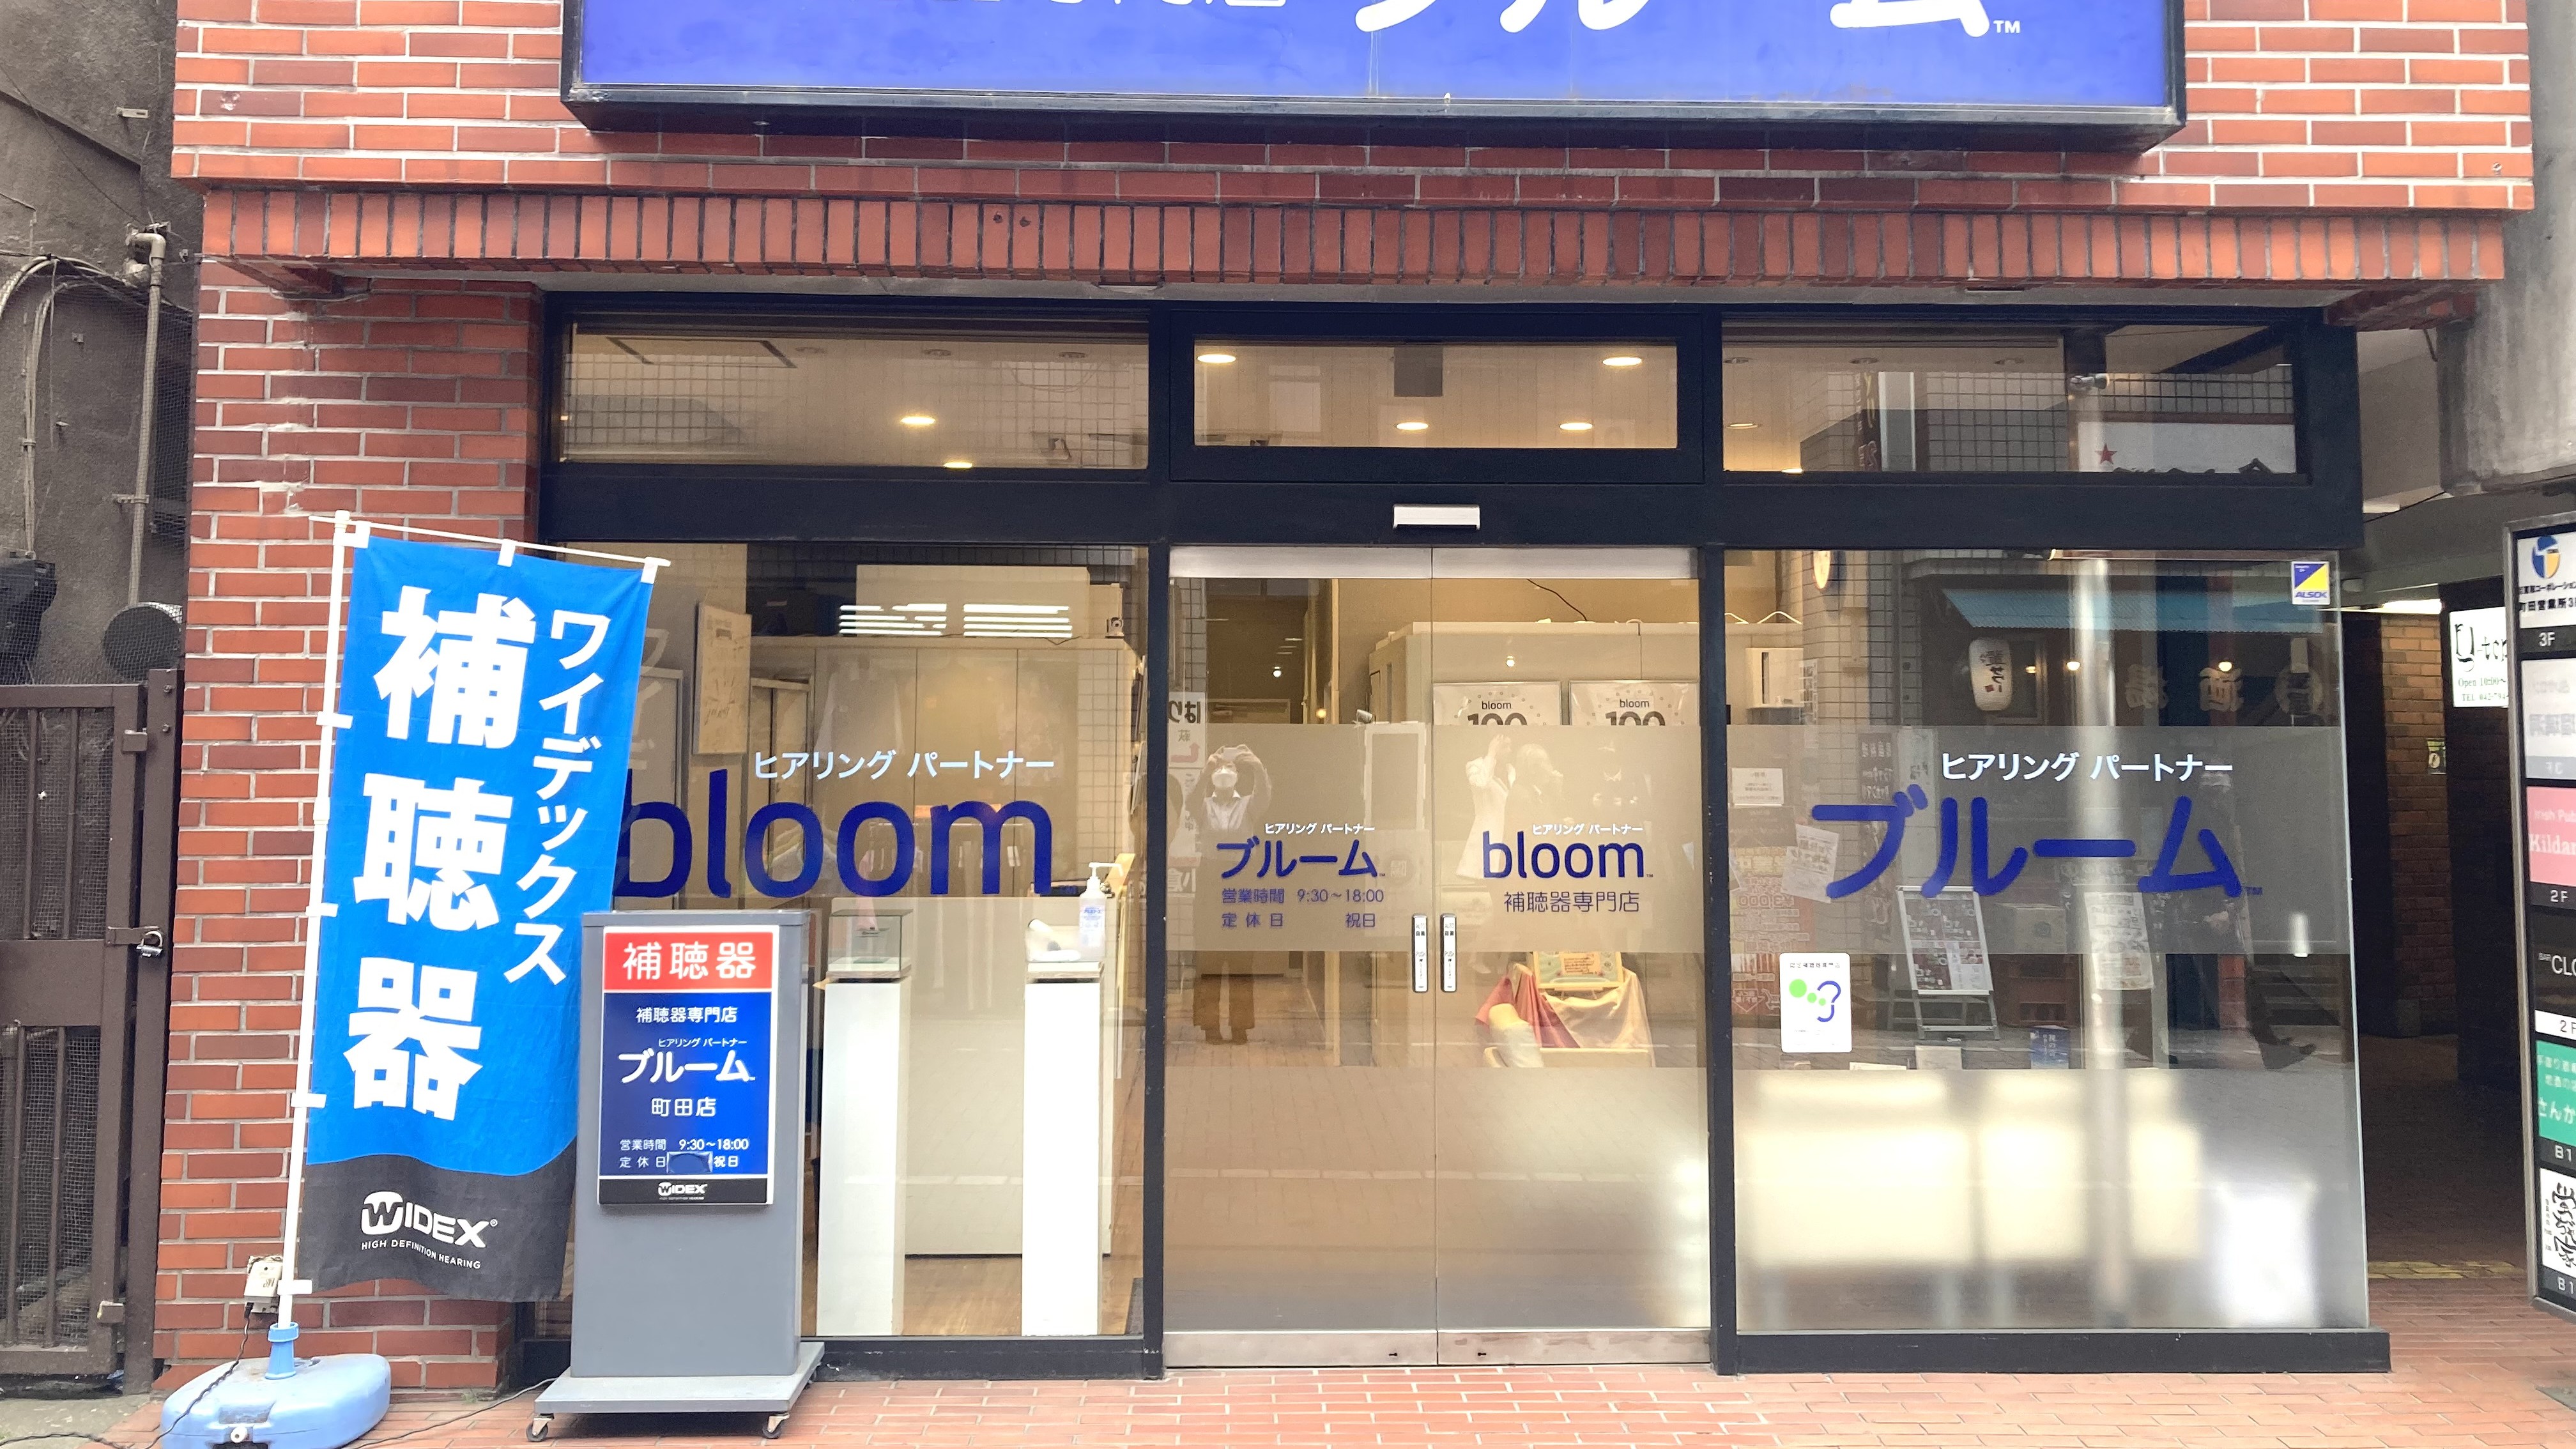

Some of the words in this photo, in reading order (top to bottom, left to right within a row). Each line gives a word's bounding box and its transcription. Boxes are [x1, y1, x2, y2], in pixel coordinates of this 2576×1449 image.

[2538, 631, 2556, 647] 3F
[2458, 678, 2477, 688] Open
[1481, 700, 1512, 710] bloom
[1619, 698, 1650, 709] bloom
[754, 749, 896, 780] ヒアリング
[907, 749, 1055, 780] パートナー
[1942, 751, 2080, 781] ヒアリング
[2090, 753, 2233, 781] パートナー
[503, 609, 611, 986] ワイデックス
[613, 769, 1053, 899] bloom
[1265, 822, 1317, 834] ヒアリング
[1321, 823, 1375, 834] パートナー
[1533, 823, 1585, 836] ヒアリング
[1589, 824, 1643, 835] パートナー
[1811, 784, 2242, 900] ブルーム
[343, 585, 537, 1121] 補聴器
[1216, 835, 1378, 878] ブルーム
[1482, 831, 1644, 879] bloom
[1222, 887, 1285, 904] 営業時間
[1504, 891, 1640, 912] 補聴器専門店
[2550, 889, 2569, 903] 2F
[1346, 913, 1375, 928] 祝日
[622, 941, 756, 981] 補聴器
[636, 1006, 739, 1023] 補聴器専門店
[658, 1038, 701, 1047] ヒアリング
[703, 1038, 747, 1047] パートナー
[618, 1047, 749, 1083] ブルーム
[651, 1096, 716, 1117] 町田店
[620, 1138, 666, 1151] 営業時間
[713, 1155, 739, 1168] 祝日
[2555, 1146, 2572, 1162] B1
[361, 1239, 387, 1250] HIGH
[391, 1239, 437, 1259] DEFINITION
[438, 1254, 481, 1269] HEARING
[2557, 1276, 2573, 1294] B1
